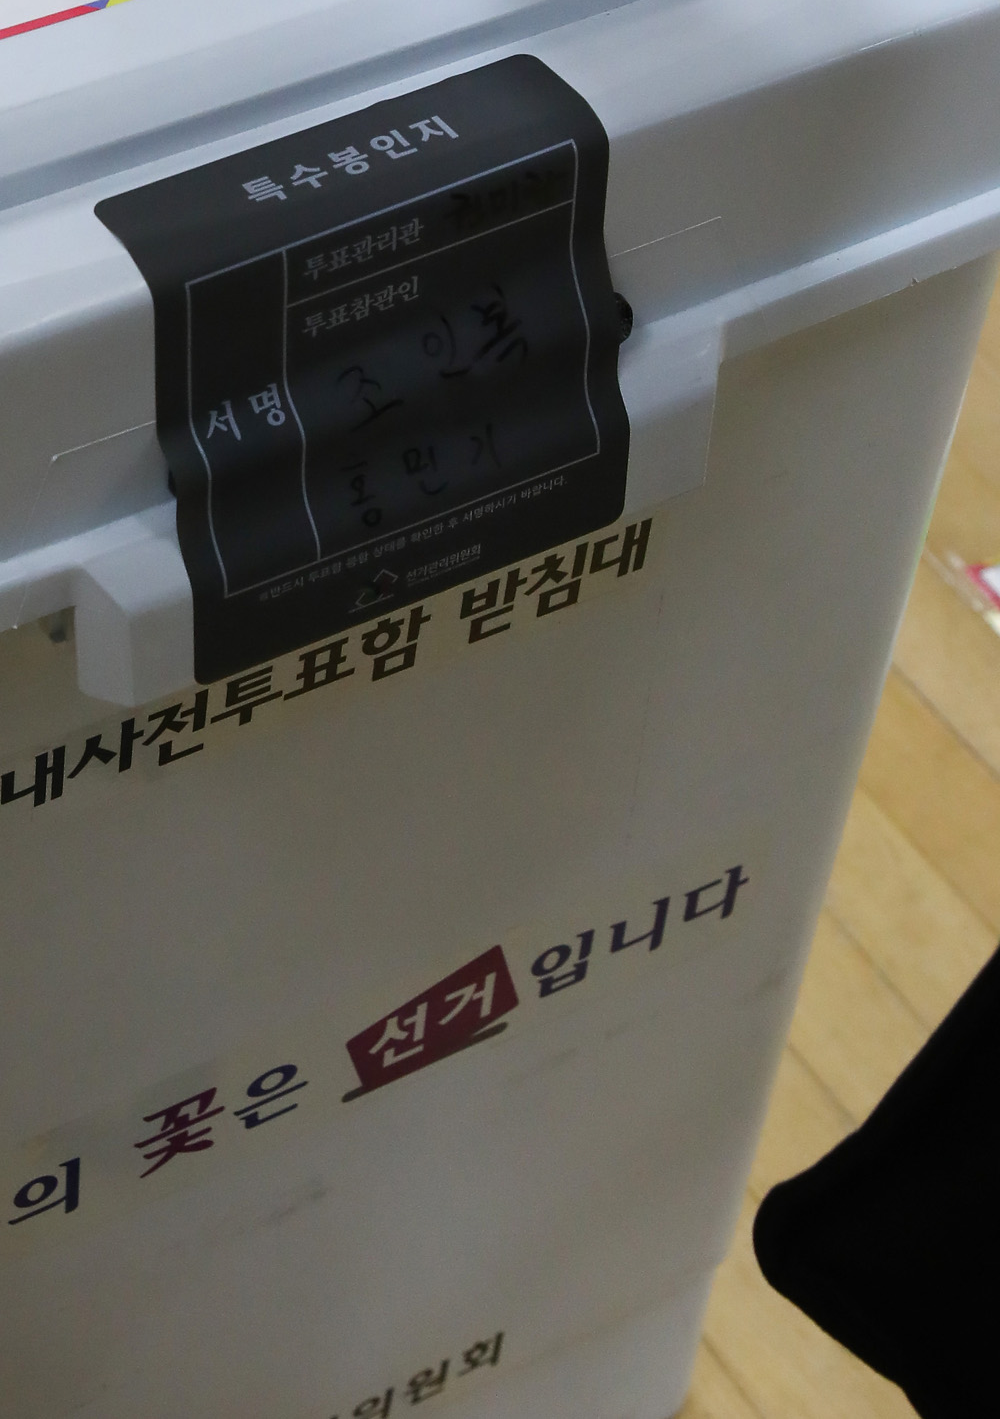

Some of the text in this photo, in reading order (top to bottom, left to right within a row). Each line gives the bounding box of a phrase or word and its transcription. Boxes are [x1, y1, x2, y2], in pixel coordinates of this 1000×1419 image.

[241, 115, 459, 204] 특수봉인지
[303, 218, 425, 280] 투표관리관
[303, 276, 421, 339] 투표참관인
[205, 382, 286, 442] 서명
[405, 543, 482, 581] 선거관리위원회
[459, 518, 653, 644] 받침대
[329, 1332, 505, 1419] 위원회
